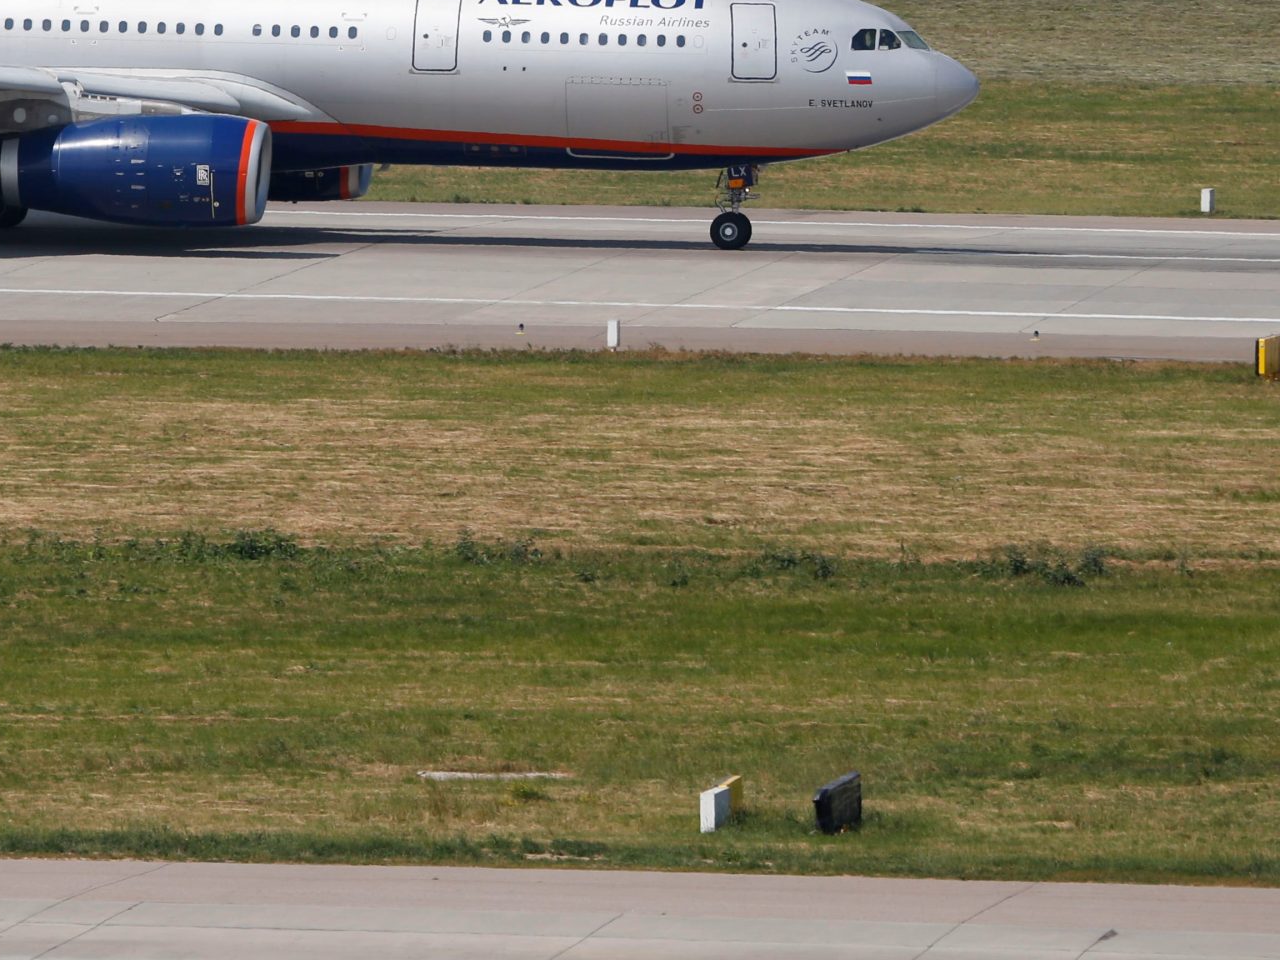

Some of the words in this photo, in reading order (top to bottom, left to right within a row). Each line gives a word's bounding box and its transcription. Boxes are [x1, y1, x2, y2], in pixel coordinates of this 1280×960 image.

[599, 14, 654, 27] Russian
[657, 16, 711, 29] Airlines
[790, 28, 830, 63] SKYTEAM
[808, 99, 818, 108] E.
[820, 99, 873, 109] SVETLANOV
[730, 166, 747, 177] LX
